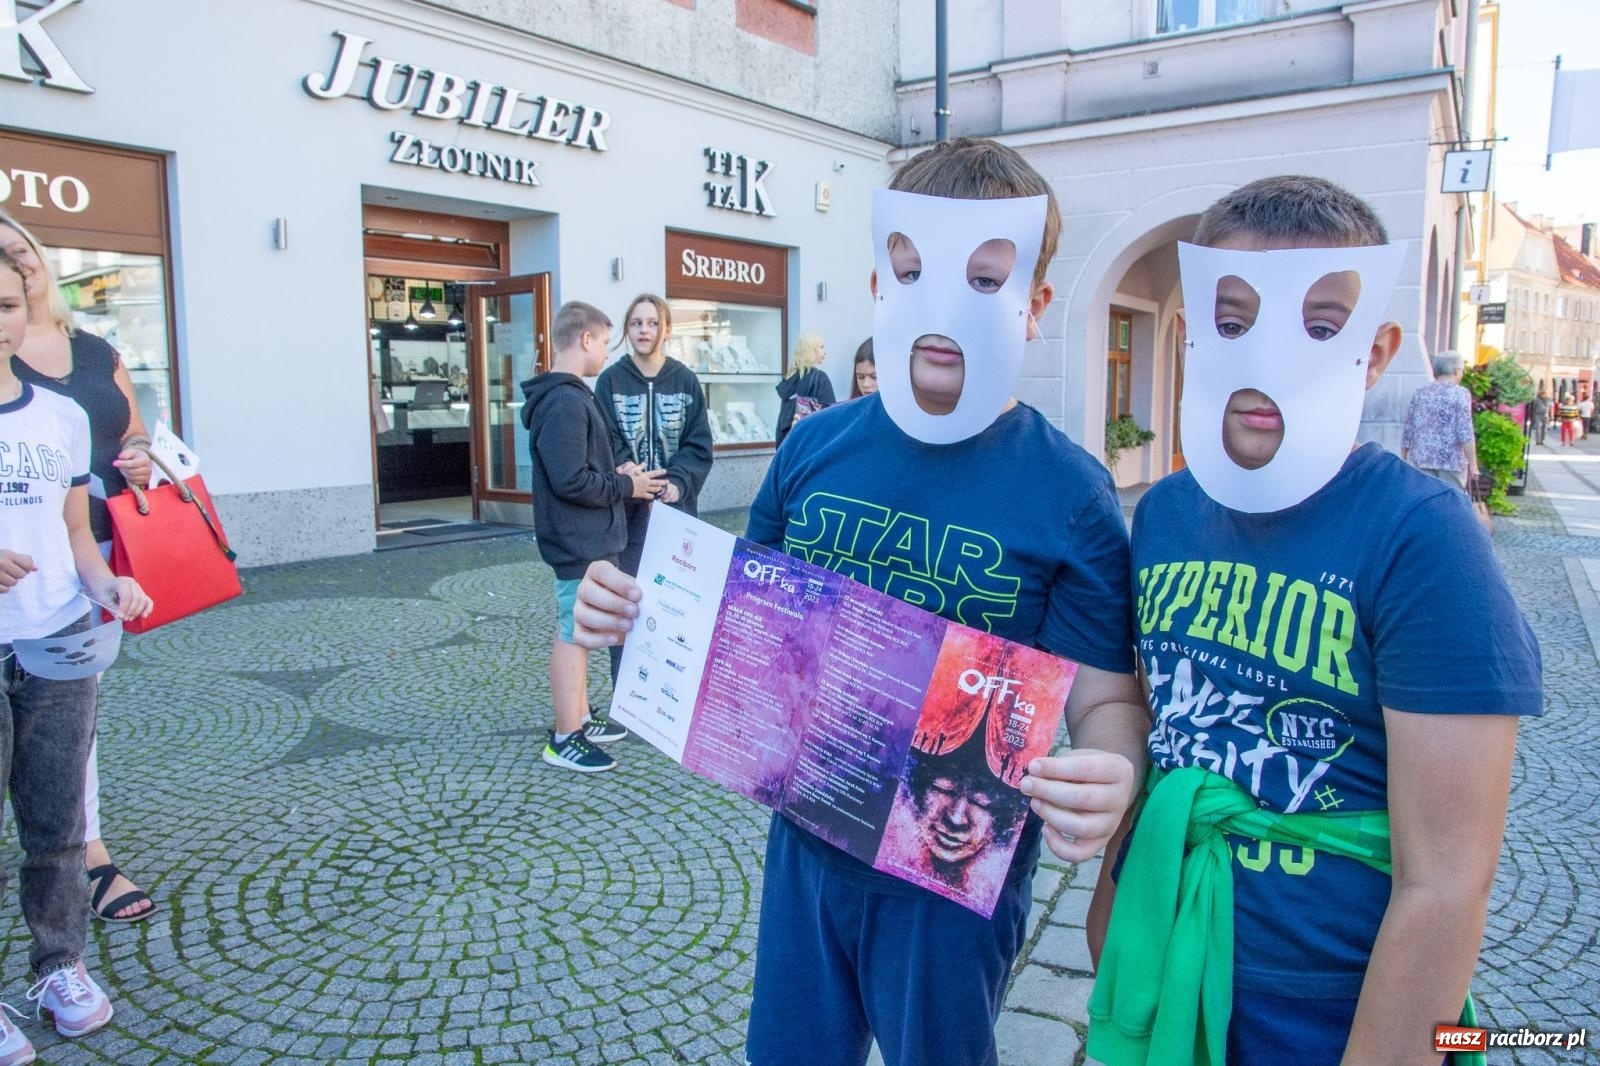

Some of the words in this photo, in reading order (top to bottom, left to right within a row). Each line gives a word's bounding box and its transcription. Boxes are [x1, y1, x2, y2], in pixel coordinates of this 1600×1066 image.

[304, 30, 612, 151] JUBILER
[390, 130, 542, 187] ZŁOTNIK
[0, 168, 90, 213] TO
[682, 248, 766, 285] SREBRO
[785, 492, 1020, 597] STAR
[746, 591, 774, 609] Program
[774, 602, 804, 620] Festiwalu
[803, 592, 820, 604] 2023
[1160, 640, 1227, 669] ORIGINAL
[1237, 663, 1290, 692] LABEL
[1003, 733, 1025, 748] 2023
[1279, 711, 1335, 739] NYC
[1281, 736, 1336, 750] ESTABLISHED
